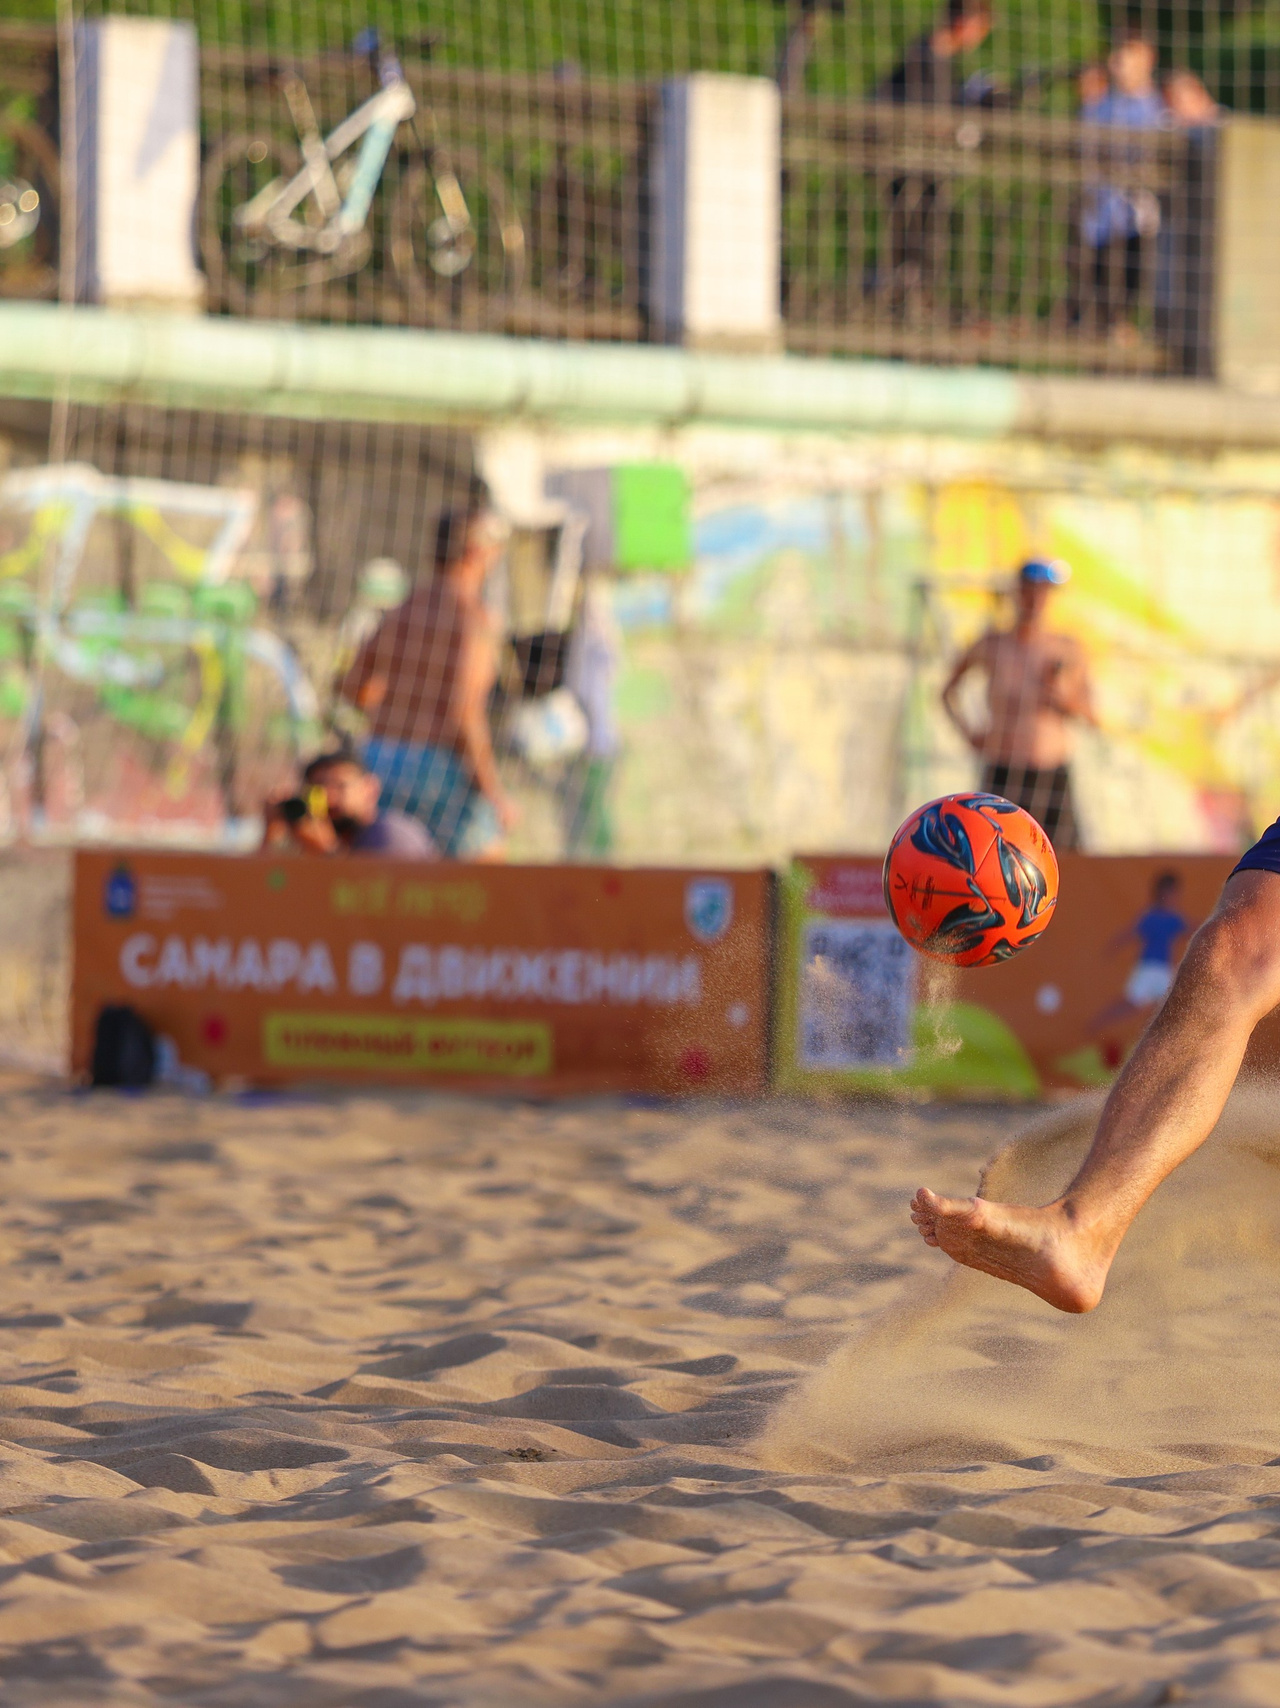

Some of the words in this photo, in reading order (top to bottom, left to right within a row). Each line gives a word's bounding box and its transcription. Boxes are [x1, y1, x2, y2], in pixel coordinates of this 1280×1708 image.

[121, 934, 337, 994] САМАРА
[347, 942, 384, 997] В
[392, 945, 702, 1007] ДВИЖЕНИИ
